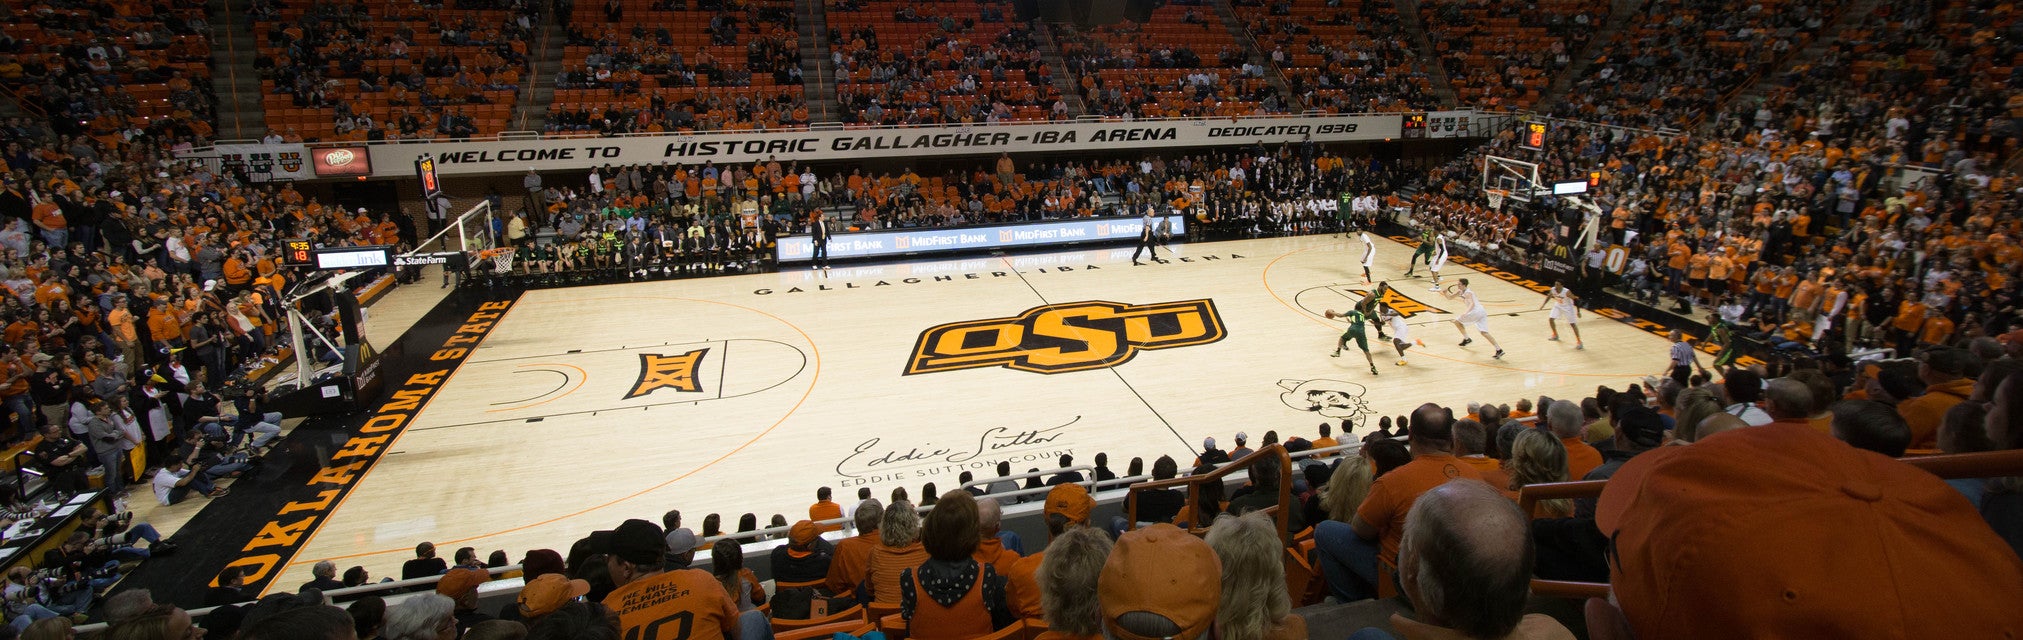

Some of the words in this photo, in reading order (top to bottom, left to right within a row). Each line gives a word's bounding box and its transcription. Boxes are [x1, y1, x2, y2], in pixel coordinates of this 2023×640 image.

[1208, 125, 1311, 137] DEDICATED
[1316, 124, 1358, 134] 1938
[439, 148, 576, 164] WELCOME
[585, 146, 621, 158] TO
[664, 138, 819, 157] HISTORIC
[1089, 127, 1176, 142] ARENA
[289, 242, 309, 250] 9:35
[294, 251, 307, 261] 18
[901, 298, 1229, 376] OSU
[207, 369, 449, 588] OKLAHOMA
[429, 300, 512, 361] STATE
[836, 437, 950, 477] Eddie
[841, 472, 905, 488] EDDIE
[916, 459, 999, 477] SUTTON
[1009, 448, 1075, 464] COURT
[622, 590, 641, 602] WE
[645, 581, 677, 593] WILL
[622, 587, 678, 607] ALWAYS
